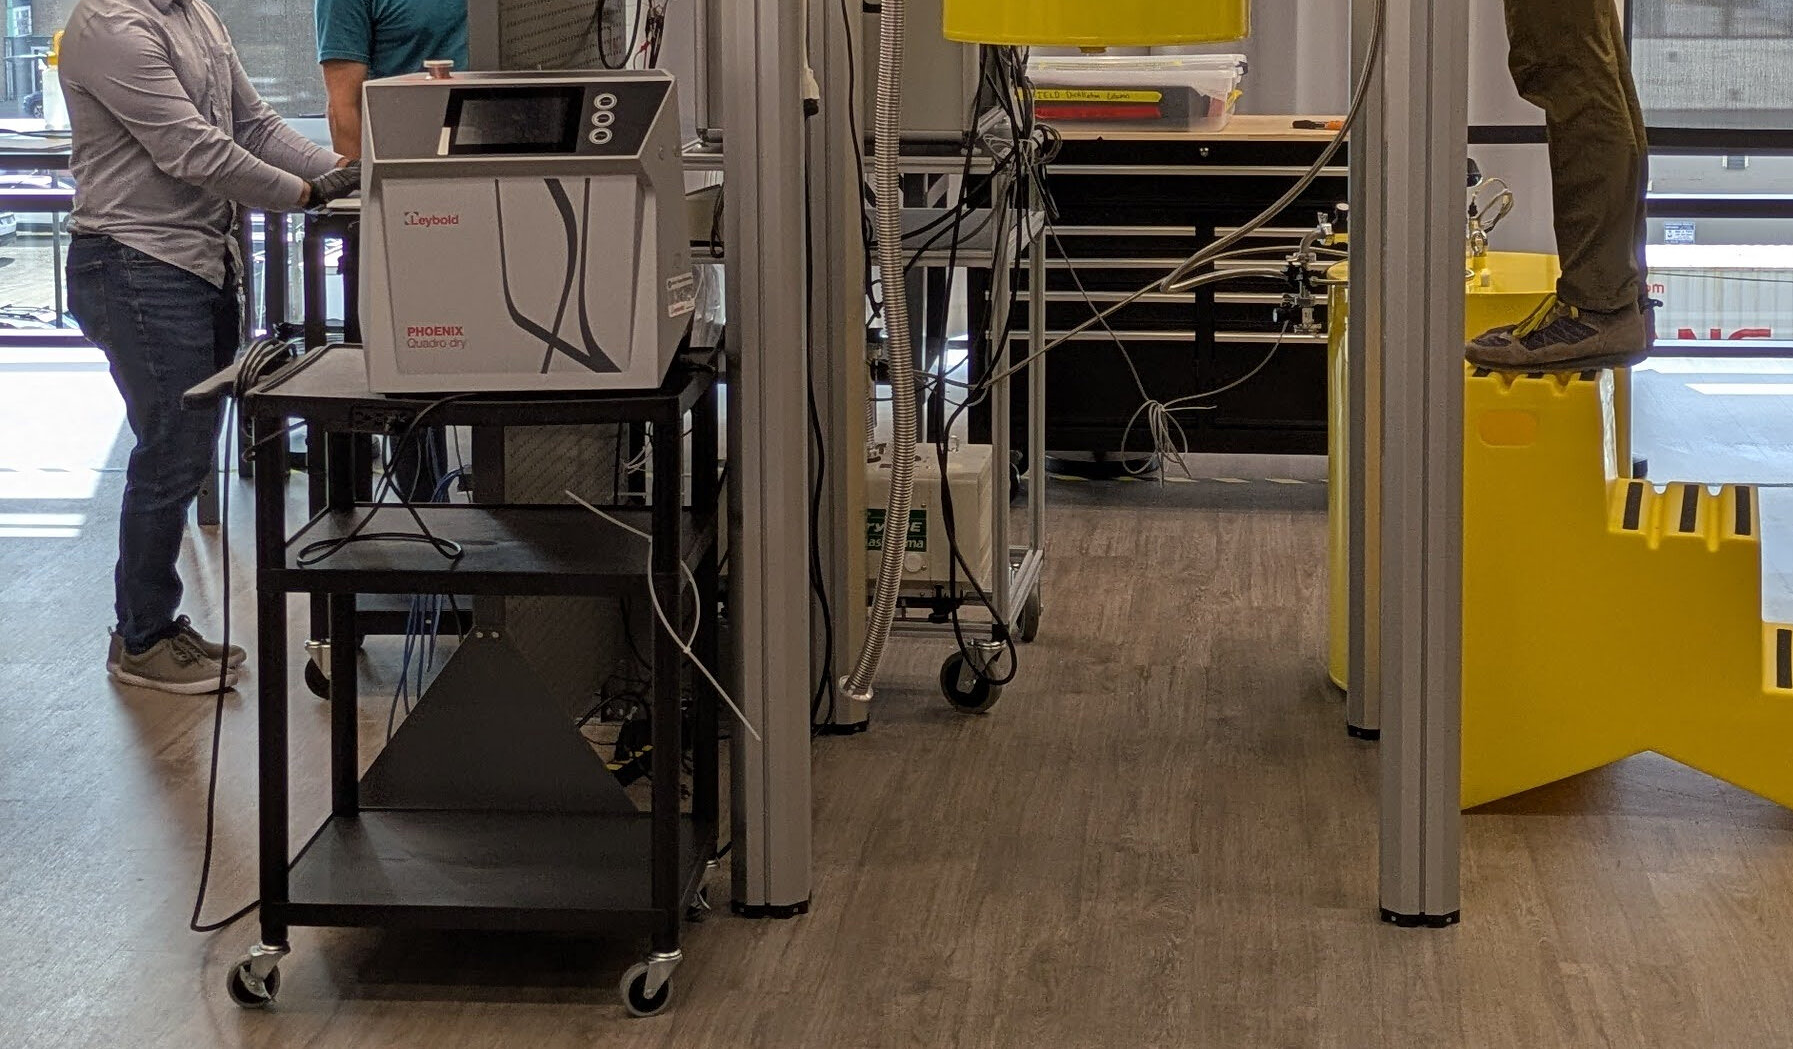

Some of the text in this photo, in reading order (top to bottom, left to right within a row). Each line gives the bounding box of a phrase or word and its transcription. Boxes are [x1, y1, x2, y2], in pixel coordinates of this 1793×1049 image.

[410, 213, 459, 228] Leybold
[407, 326, 464, 337] PHOENIX
[407, 337, 465, 350] Quadro dry
